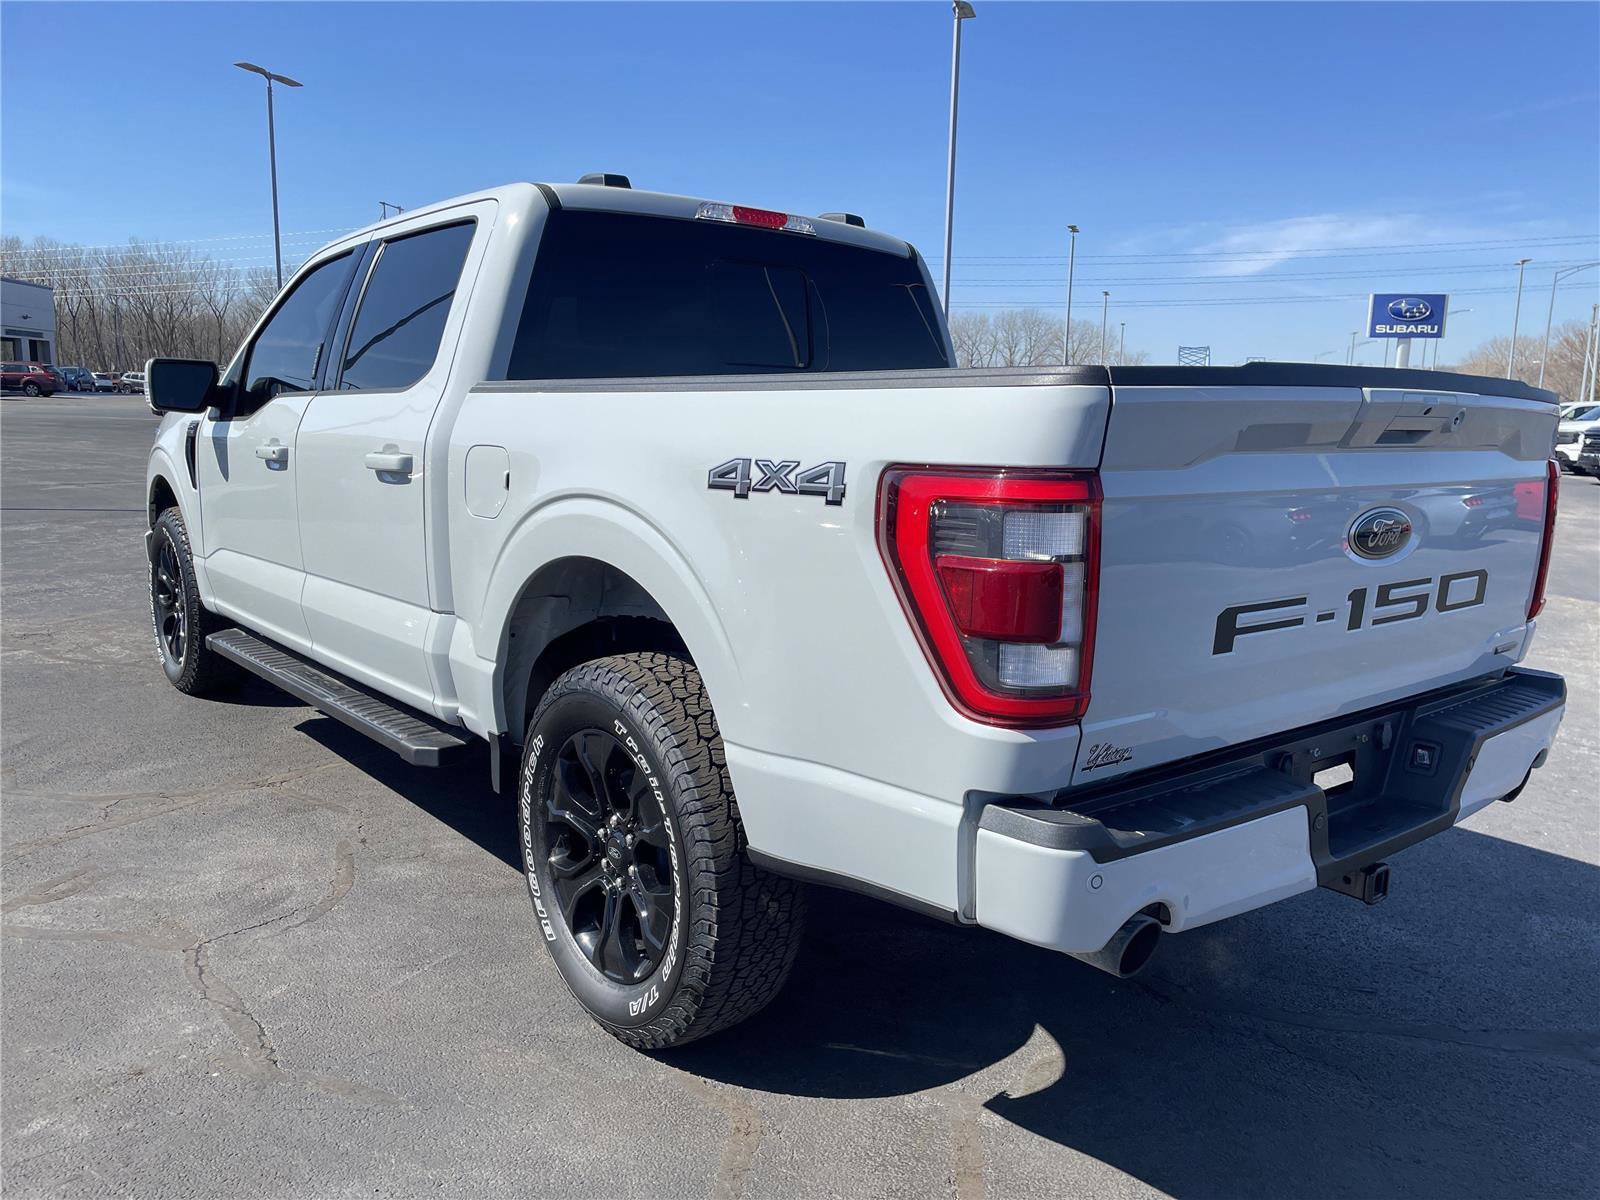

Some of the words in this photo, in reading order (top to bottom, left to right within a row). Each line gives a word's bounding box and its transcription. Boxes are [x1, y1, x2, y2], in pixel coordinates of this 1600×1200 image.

[1375, 324, 1438, 334] SUBARU
[1368, 518, 1402, 548] Ford
[1212, 568, 1488, 656] F-150
